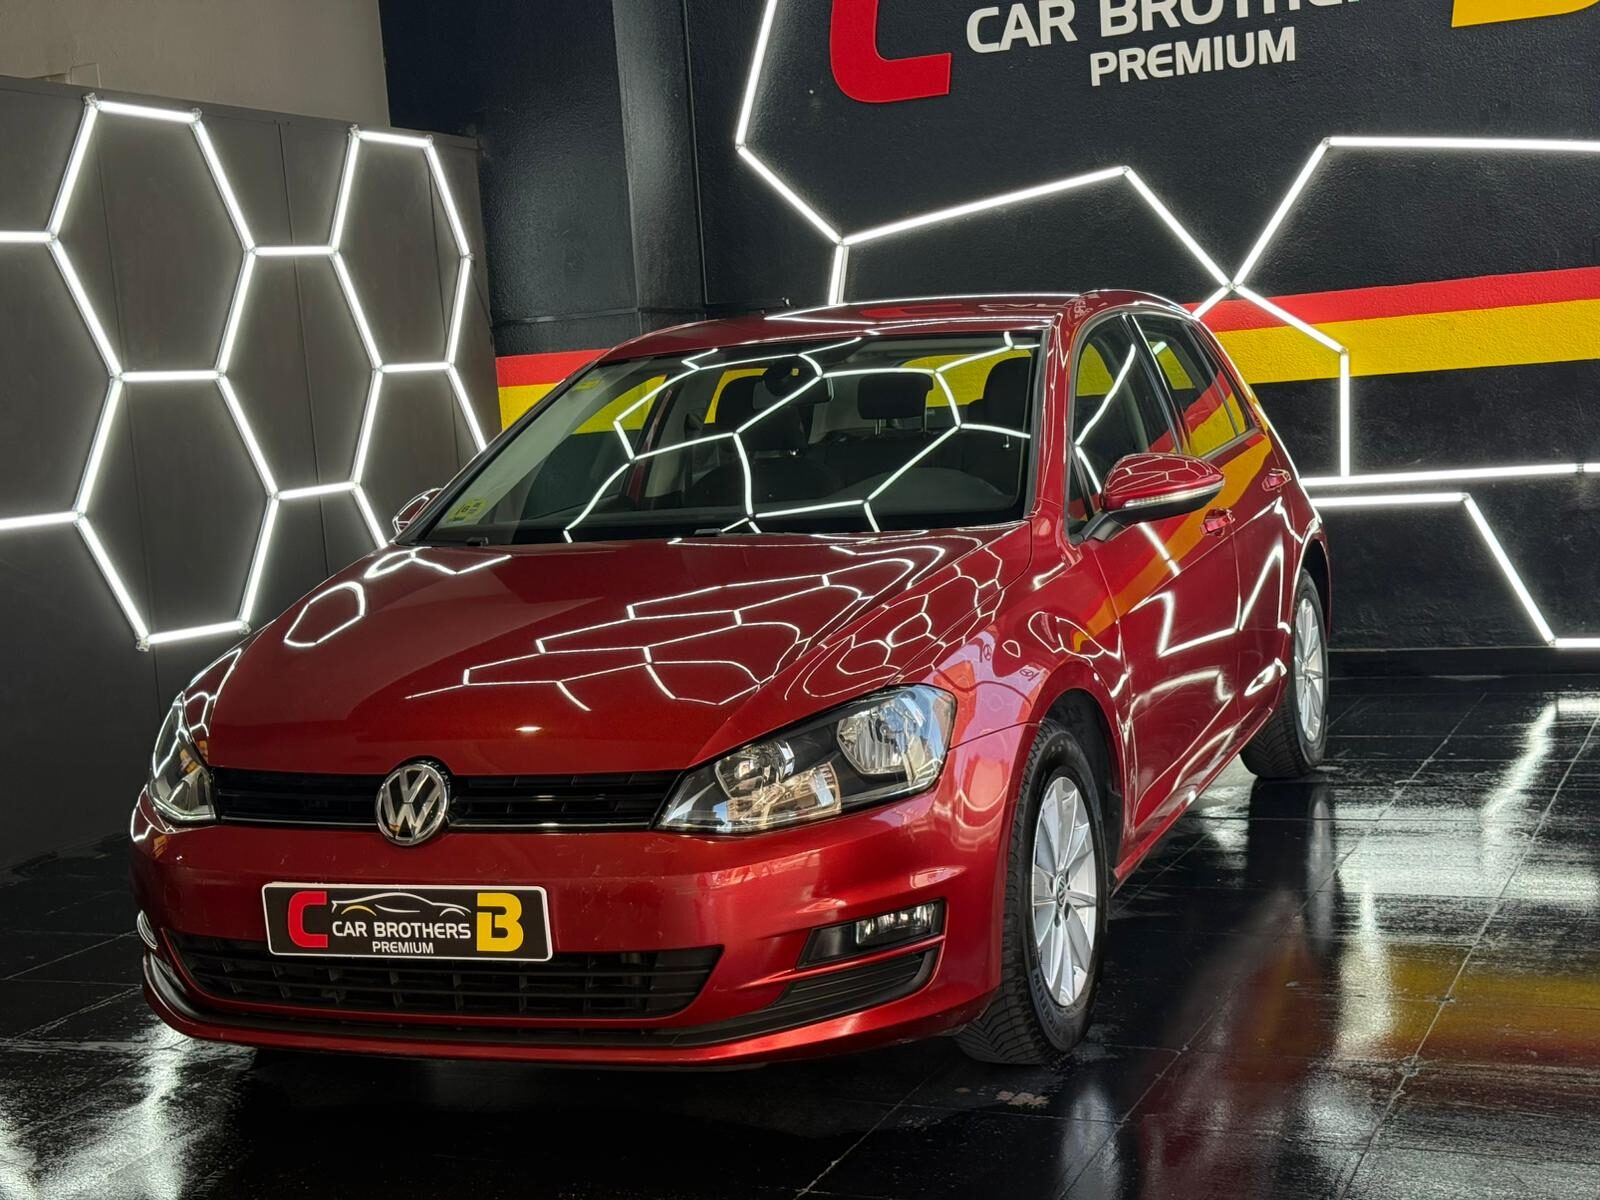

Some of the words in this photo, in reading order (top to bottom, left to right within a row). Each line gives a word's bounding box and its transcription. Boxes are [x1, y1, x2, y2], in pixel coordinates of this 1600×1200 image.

[966, 0, 1078, 53] CAR
[1090, 26, 1296, 86] PREMIUM
[288, 891, 328, 948] C
[332, 921, 368, 937] CAR
[374, 922, 471, 939] BROTHERS
[372, 941, 434, 954] PREMIUM
